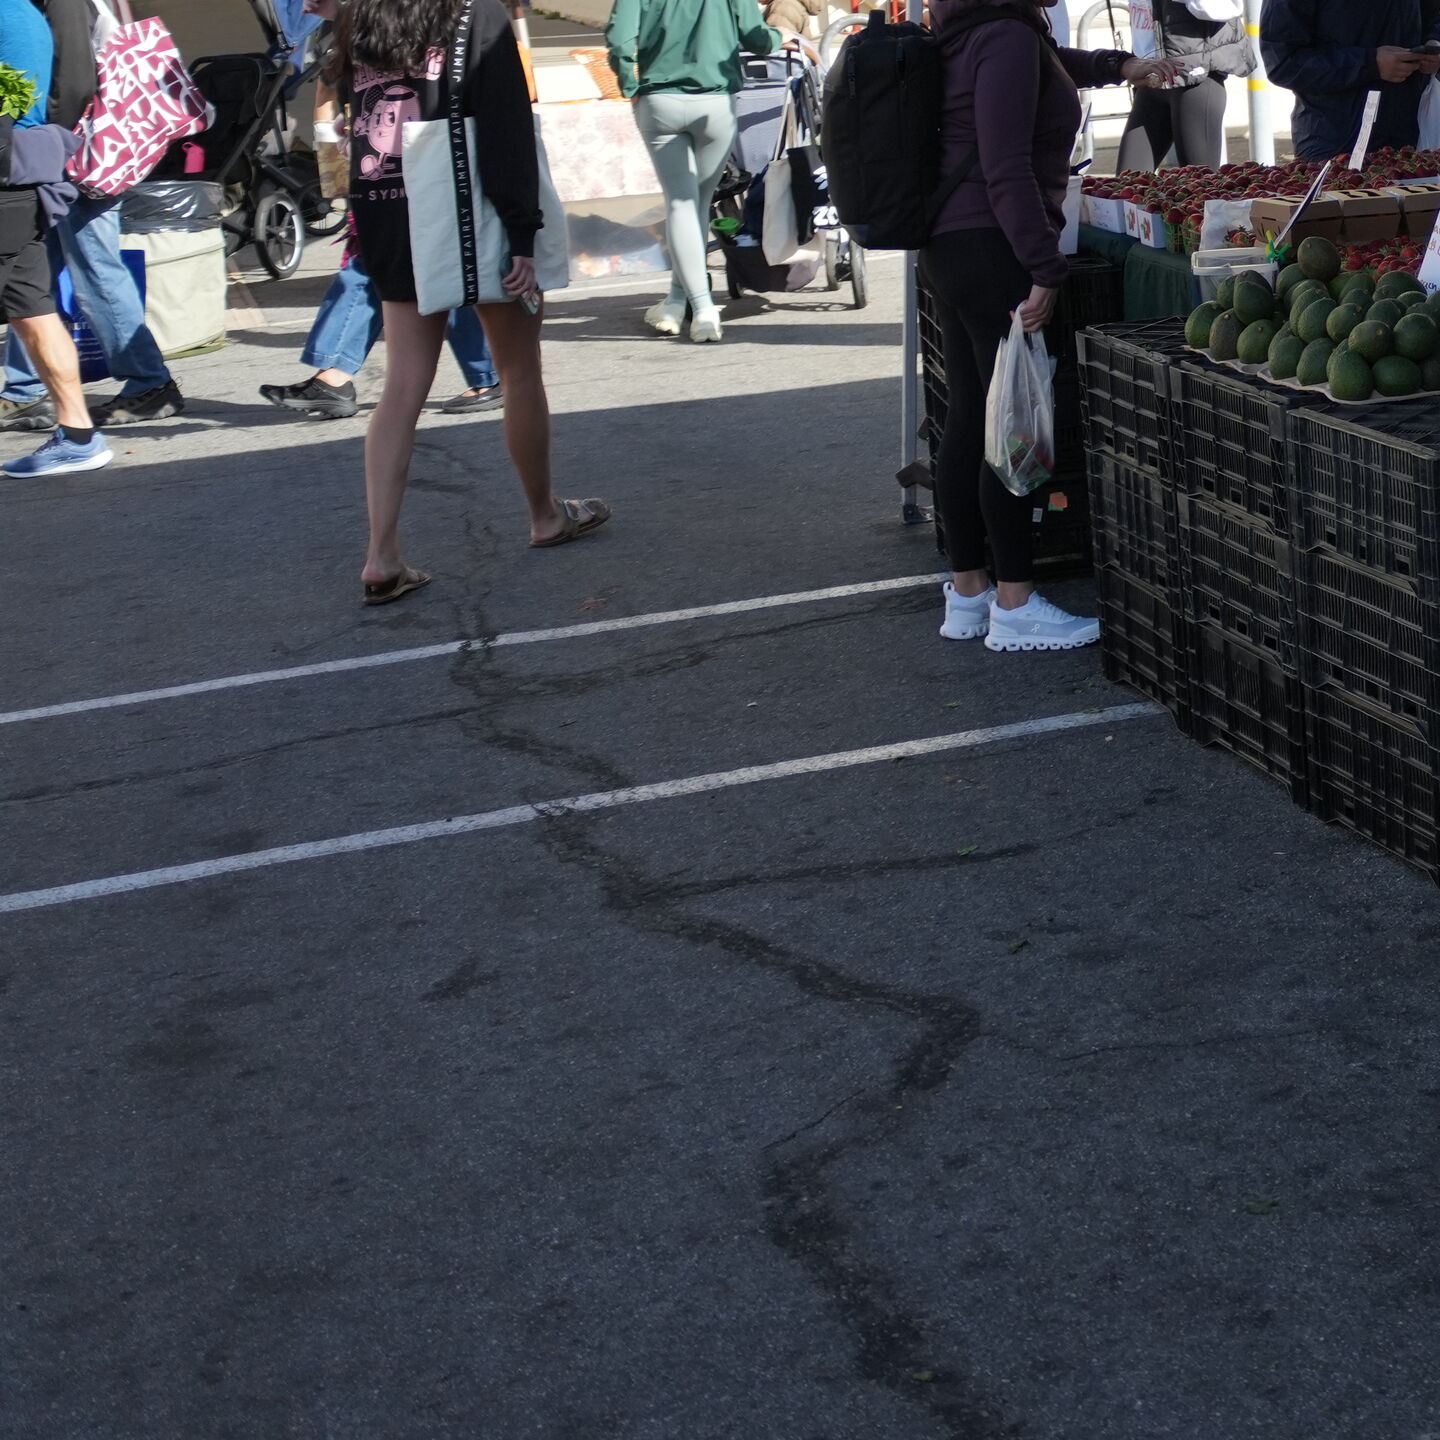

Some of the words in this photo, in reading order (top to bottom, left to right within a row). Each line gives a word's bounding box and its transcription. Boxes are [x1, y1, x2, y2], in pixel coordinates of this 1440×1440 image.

[452, 36, 466, 83] JIMMY
[449, 93, 463, 144] FAIRLY
[368, 187, 406, 201] SYDN
[455, 150, 469, 195] JIMMY
[460, 207, 474, 257] FAIRLY
